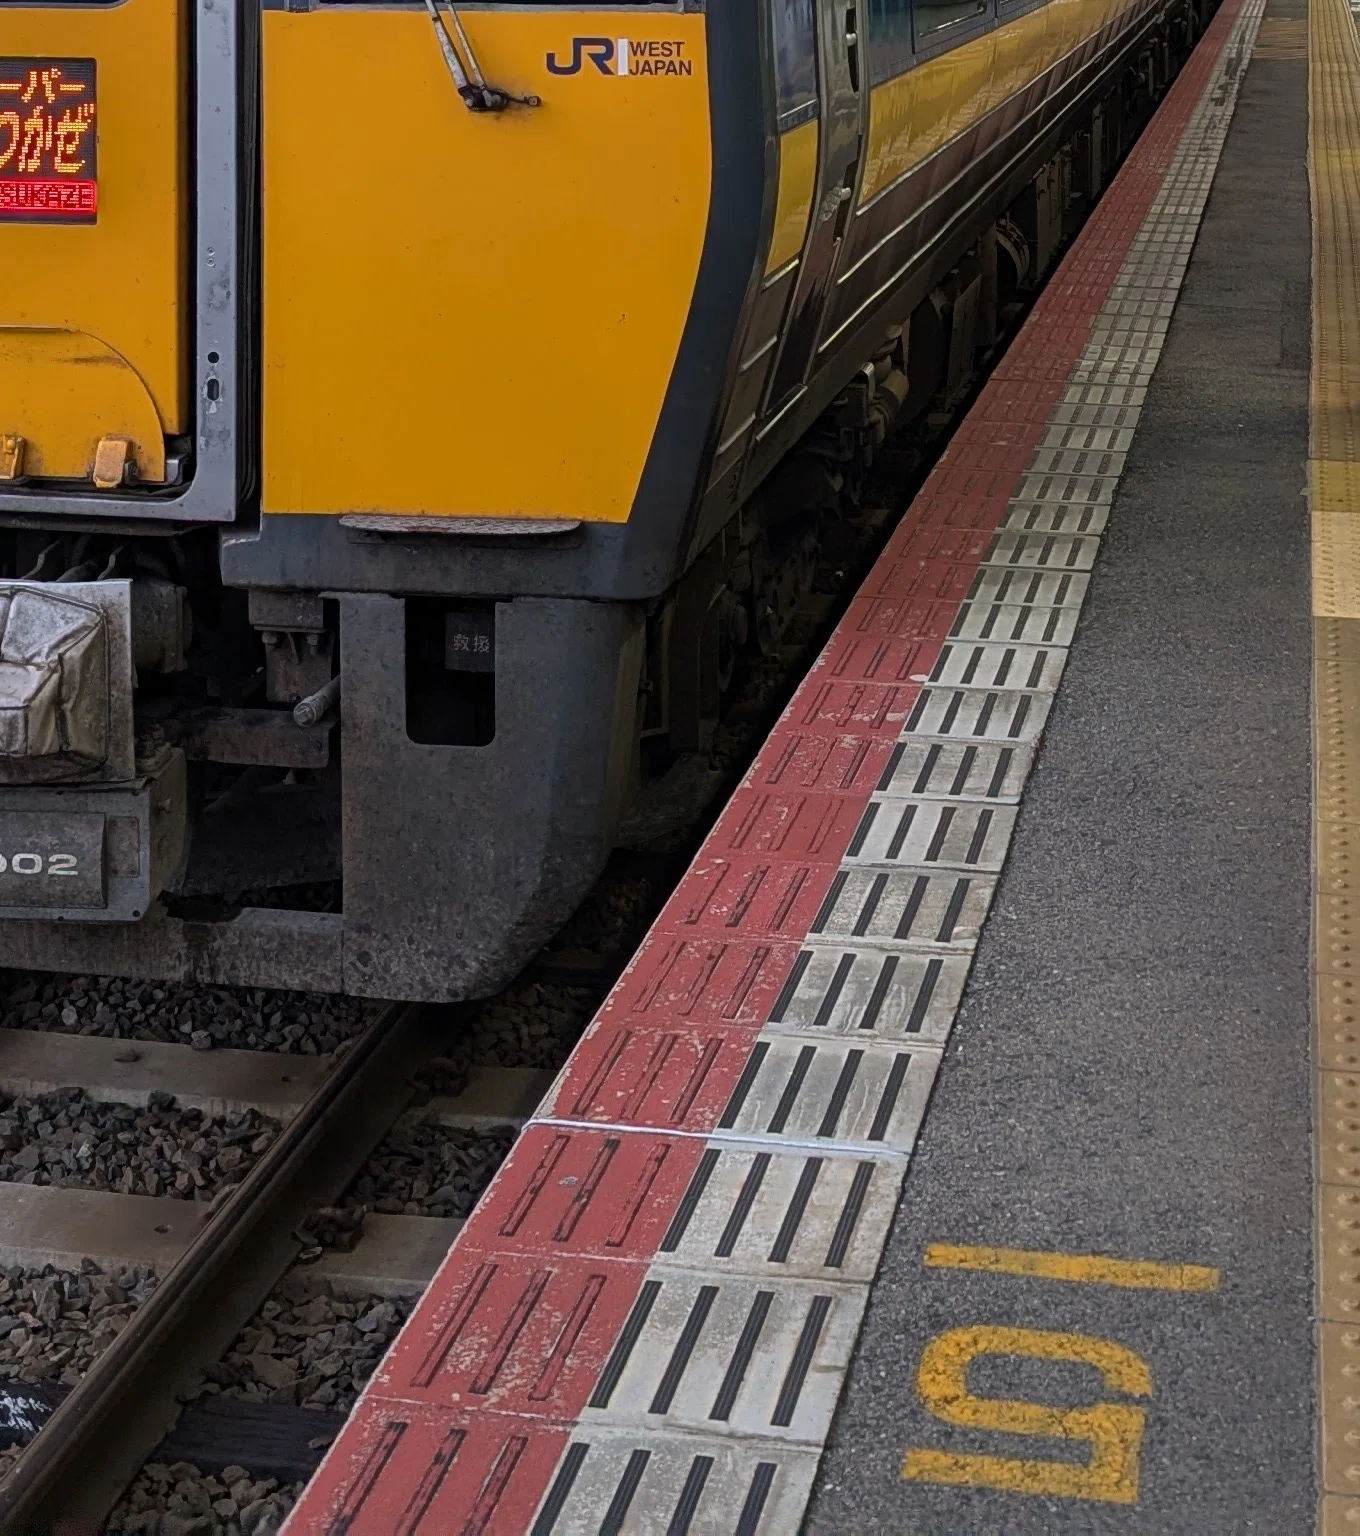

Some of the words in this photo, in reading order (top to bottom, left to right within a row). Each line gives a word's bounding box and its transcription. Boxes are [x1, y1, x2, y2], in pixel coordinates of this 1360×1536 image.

[546, 37, 615, 76] JR
[628, 41, 686, 58] WEST
[629, 59, 693, 76] JAPAN
[453, 633, 490, 653] 救援
